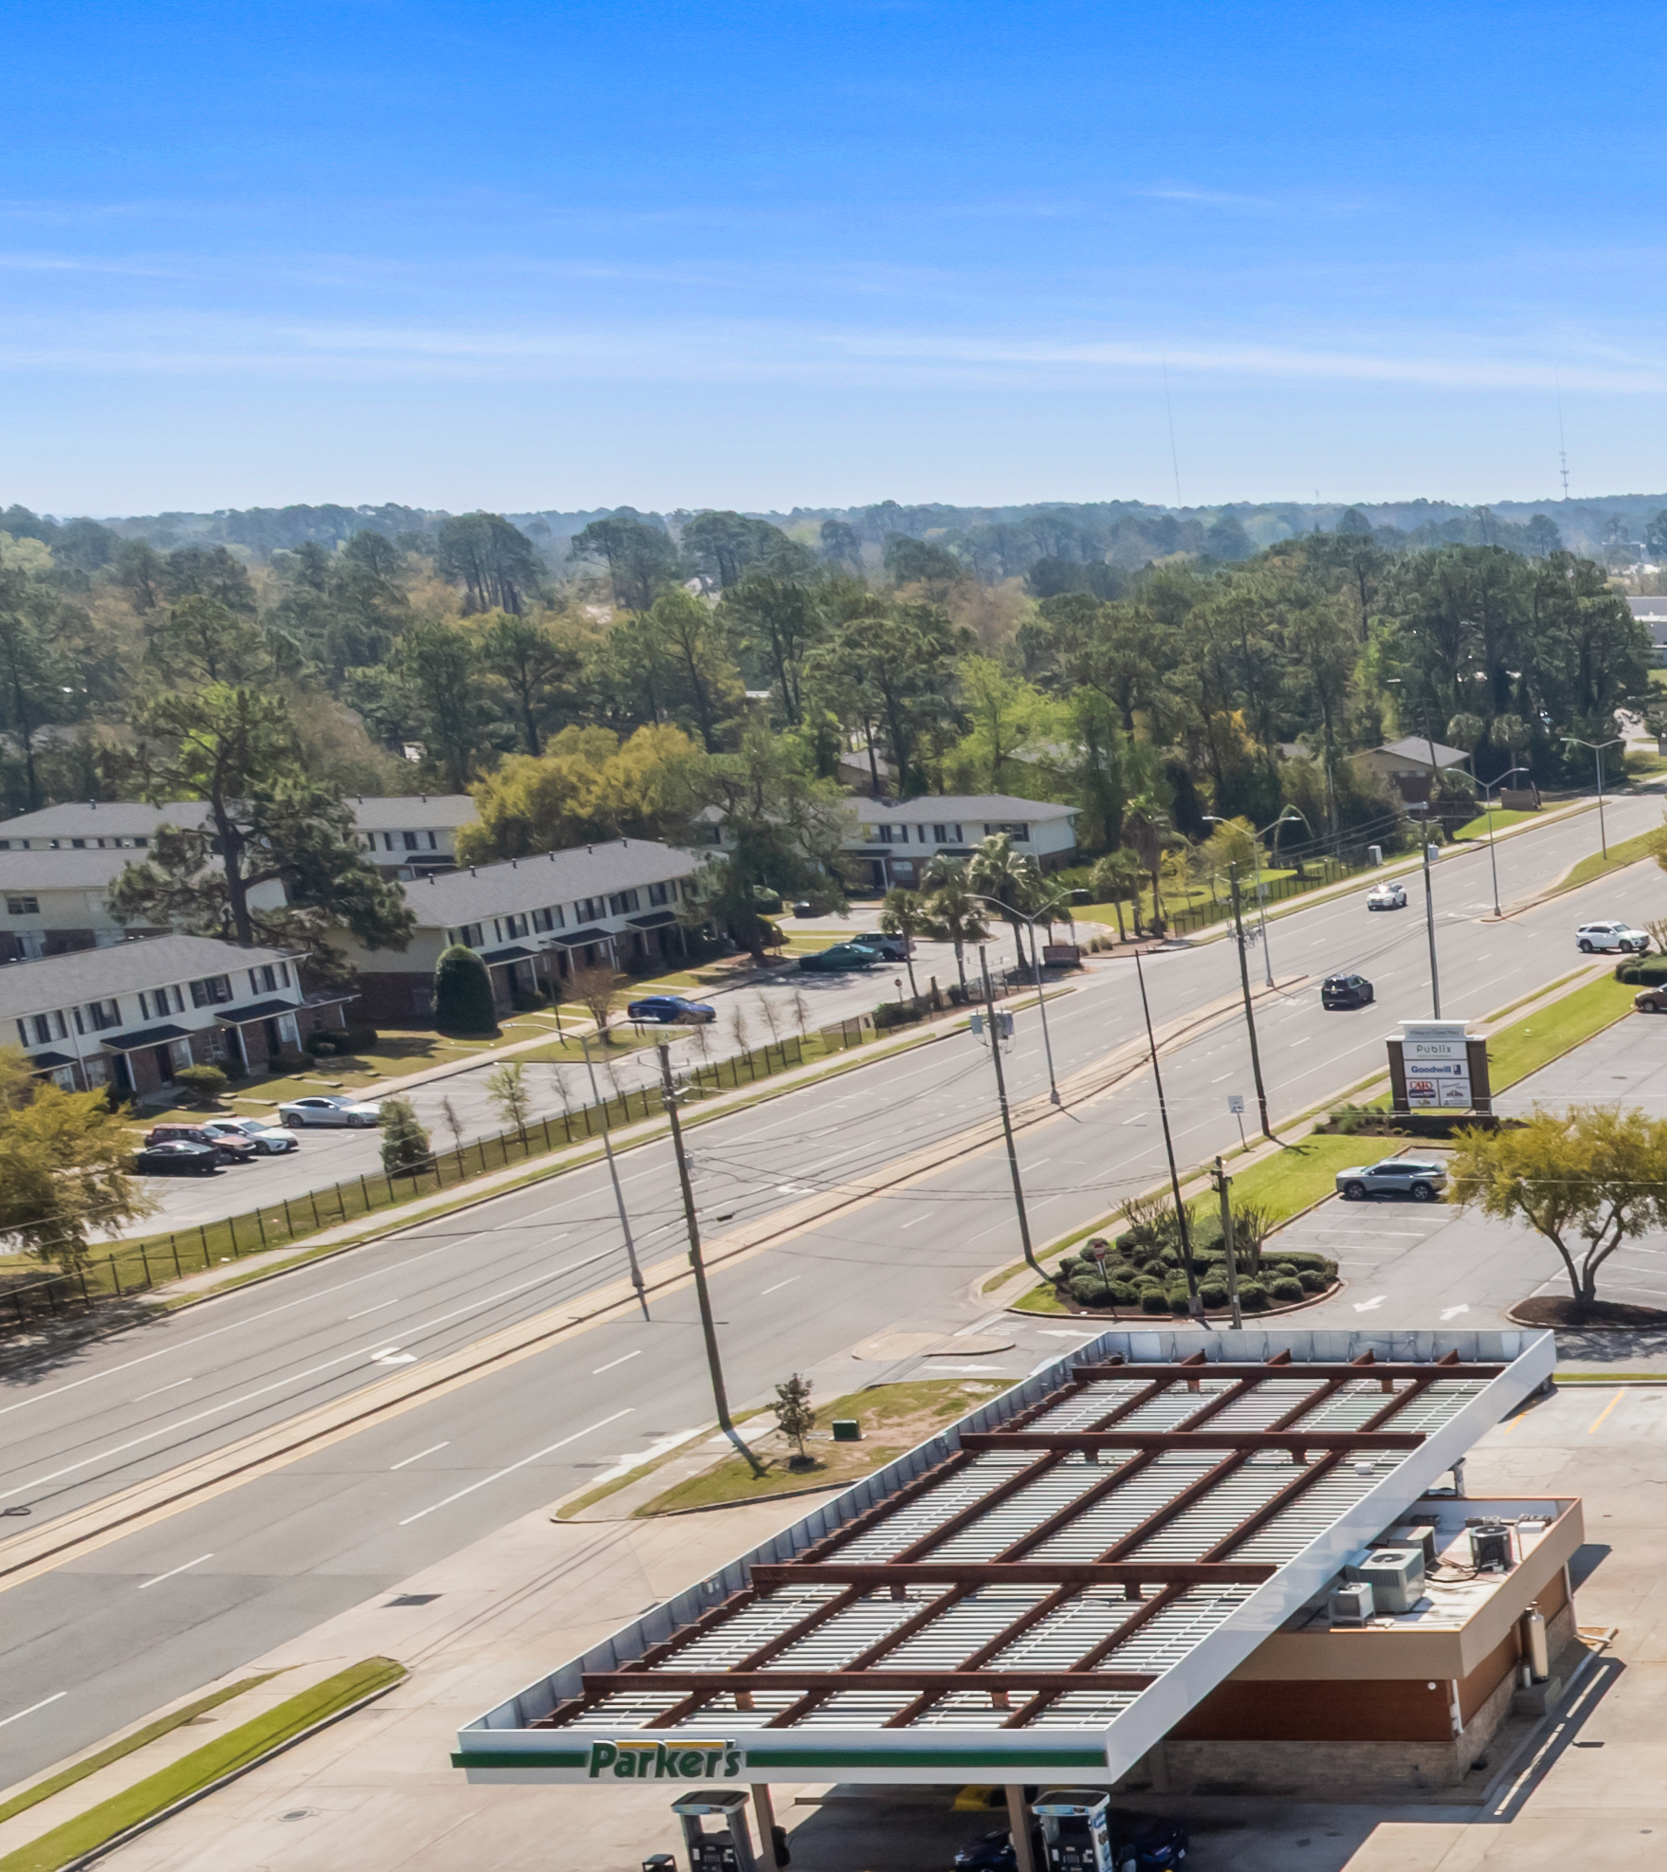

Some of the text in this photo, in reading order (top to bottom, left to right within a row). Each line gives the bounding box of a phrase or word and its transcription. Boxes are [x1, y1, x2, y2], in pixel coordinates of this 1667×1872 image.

[1416, 1045, 1451, 1053] Publix
[1411, 1066, 1451, 1074] Goodwill
[589, 1739, 743, 1778] Parker's
